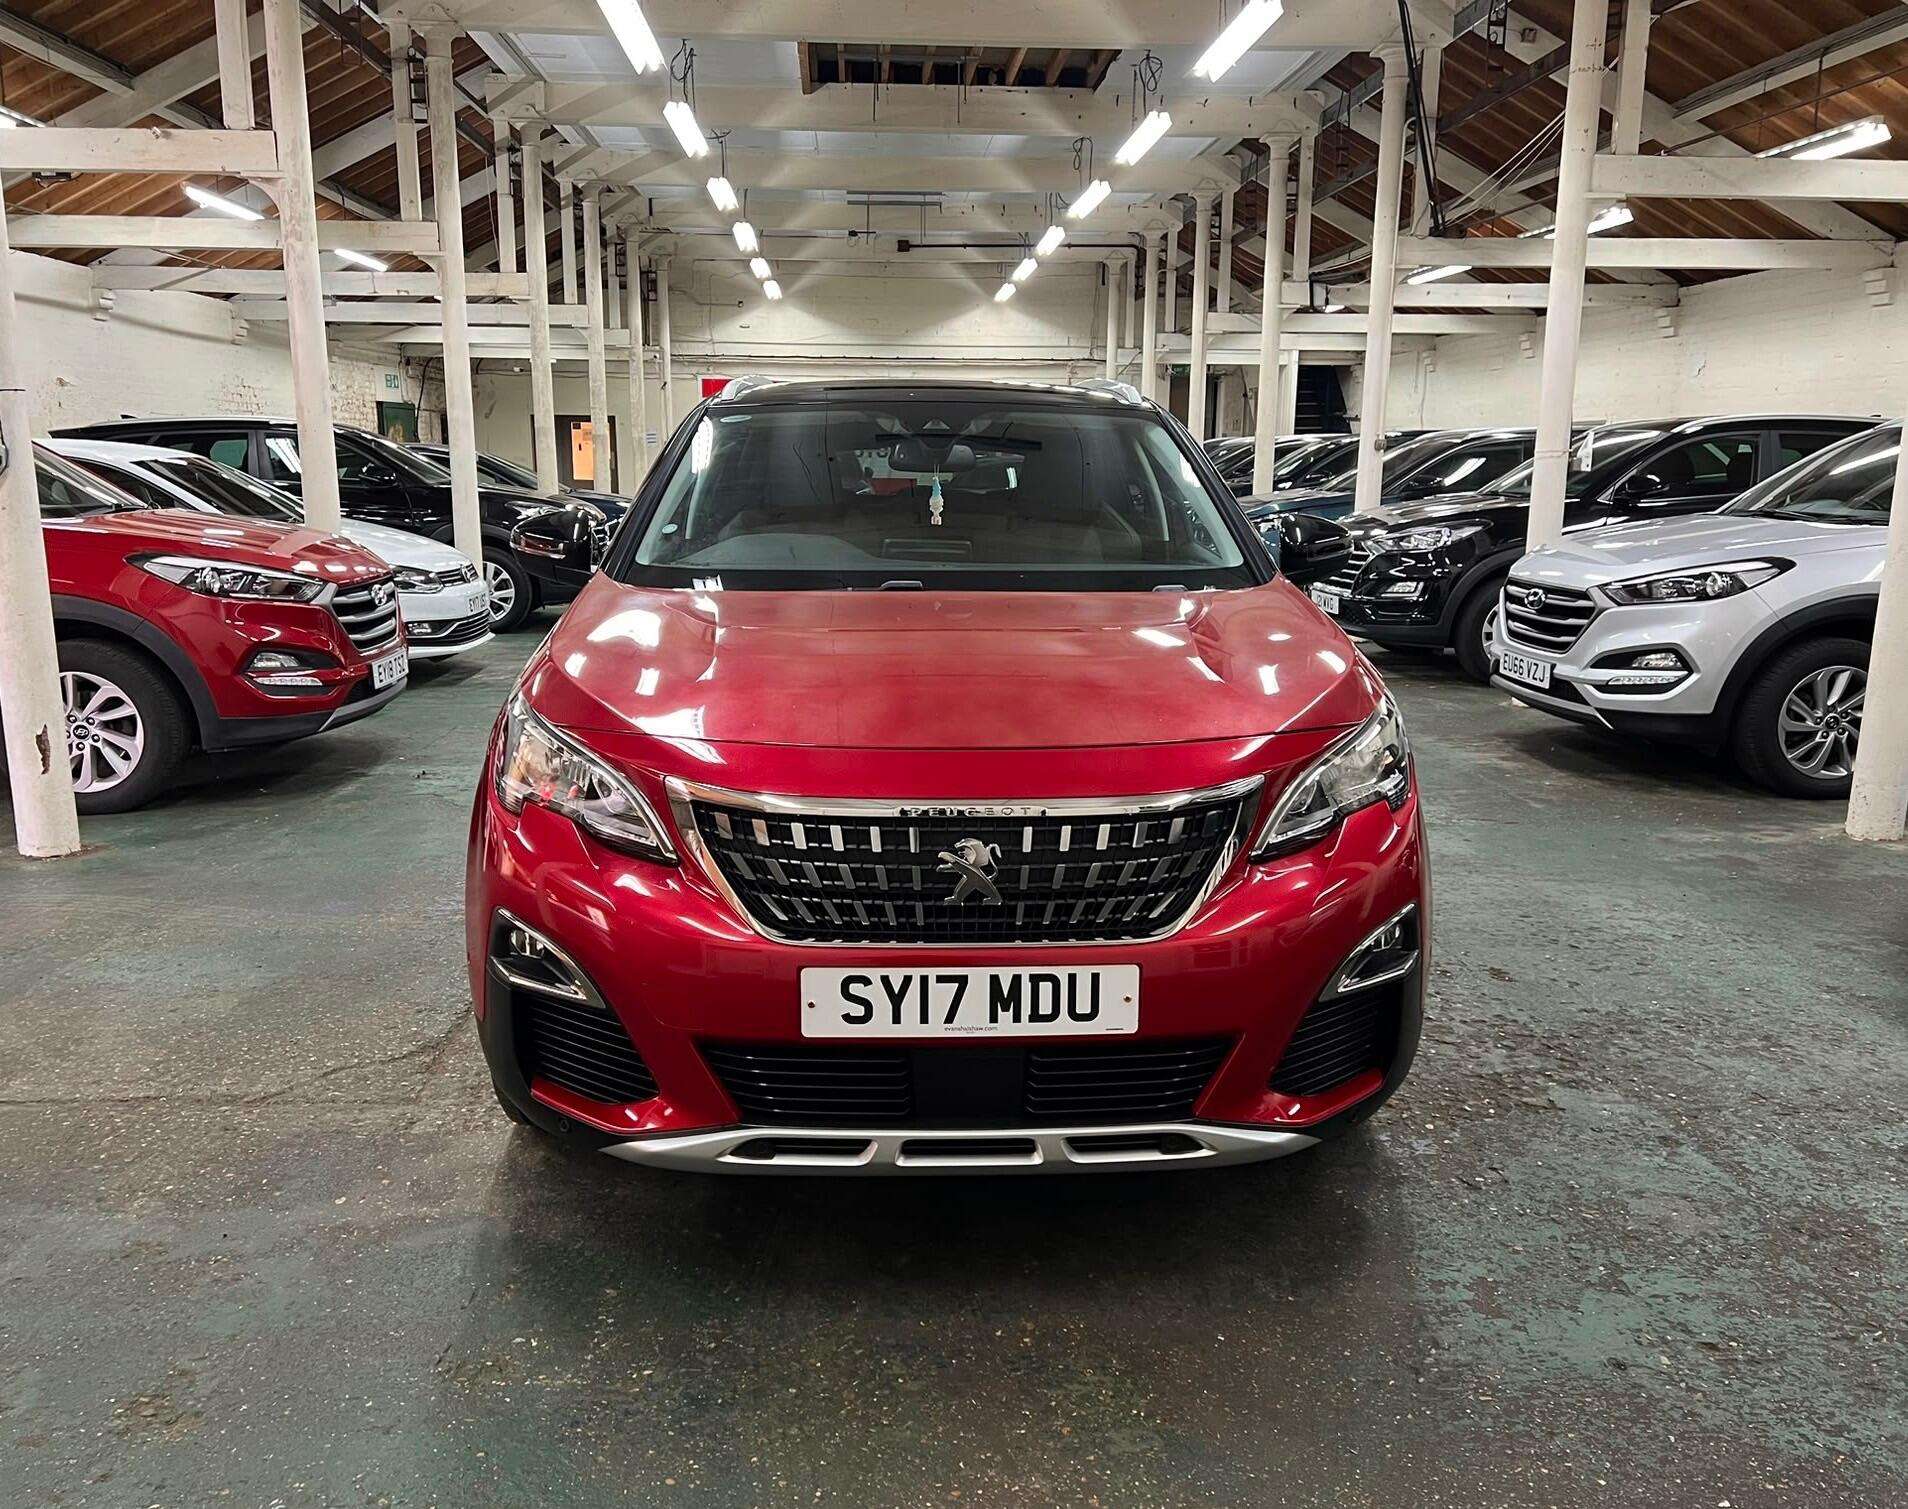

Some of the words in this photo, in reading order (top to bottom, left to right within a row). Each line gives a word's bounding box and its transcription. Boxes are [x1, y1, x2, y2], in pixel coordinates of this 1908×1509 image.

[1503, 653, 1524, 676] EU66
[910, 807, 1032, 817] PEUGEOT
[839, 973, 969, 1025] SY17
[988, 971, 1101, 1025] MDU
